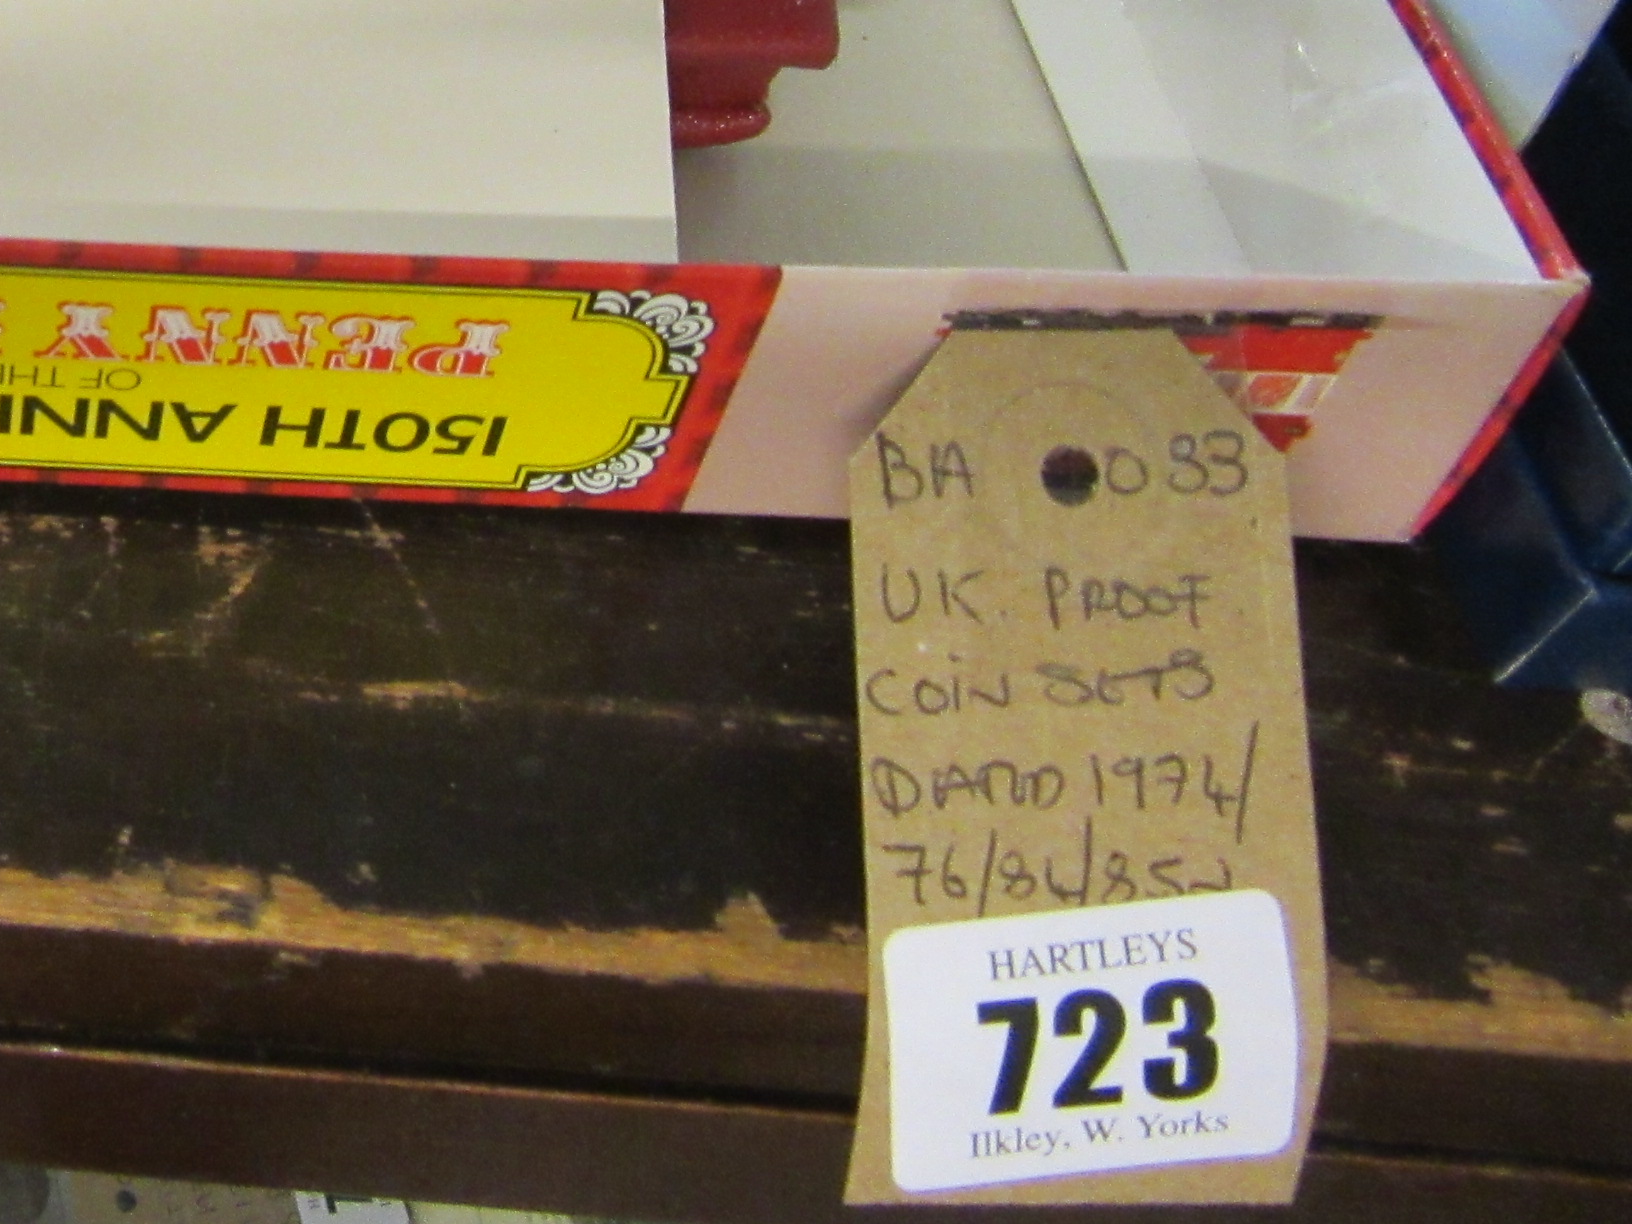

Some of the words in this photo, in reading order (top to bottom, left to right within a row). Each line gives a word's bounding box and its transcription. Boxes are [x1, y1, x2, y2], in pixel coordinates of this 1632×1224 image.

[34, 300, 512, 379] PENNY
[90, 368, 142, 392] OF
[260, 405, 508, 458] 150TH
[987, 927, 1198, 982] HARTLEYS
[977, 977, 1221, 1116] 723
[969, 1122, 1070, 1160] Ilkley,
[1081, 1118, 1124, 1145] W.
[1137, 1109, 1230, 1139] Yorks
